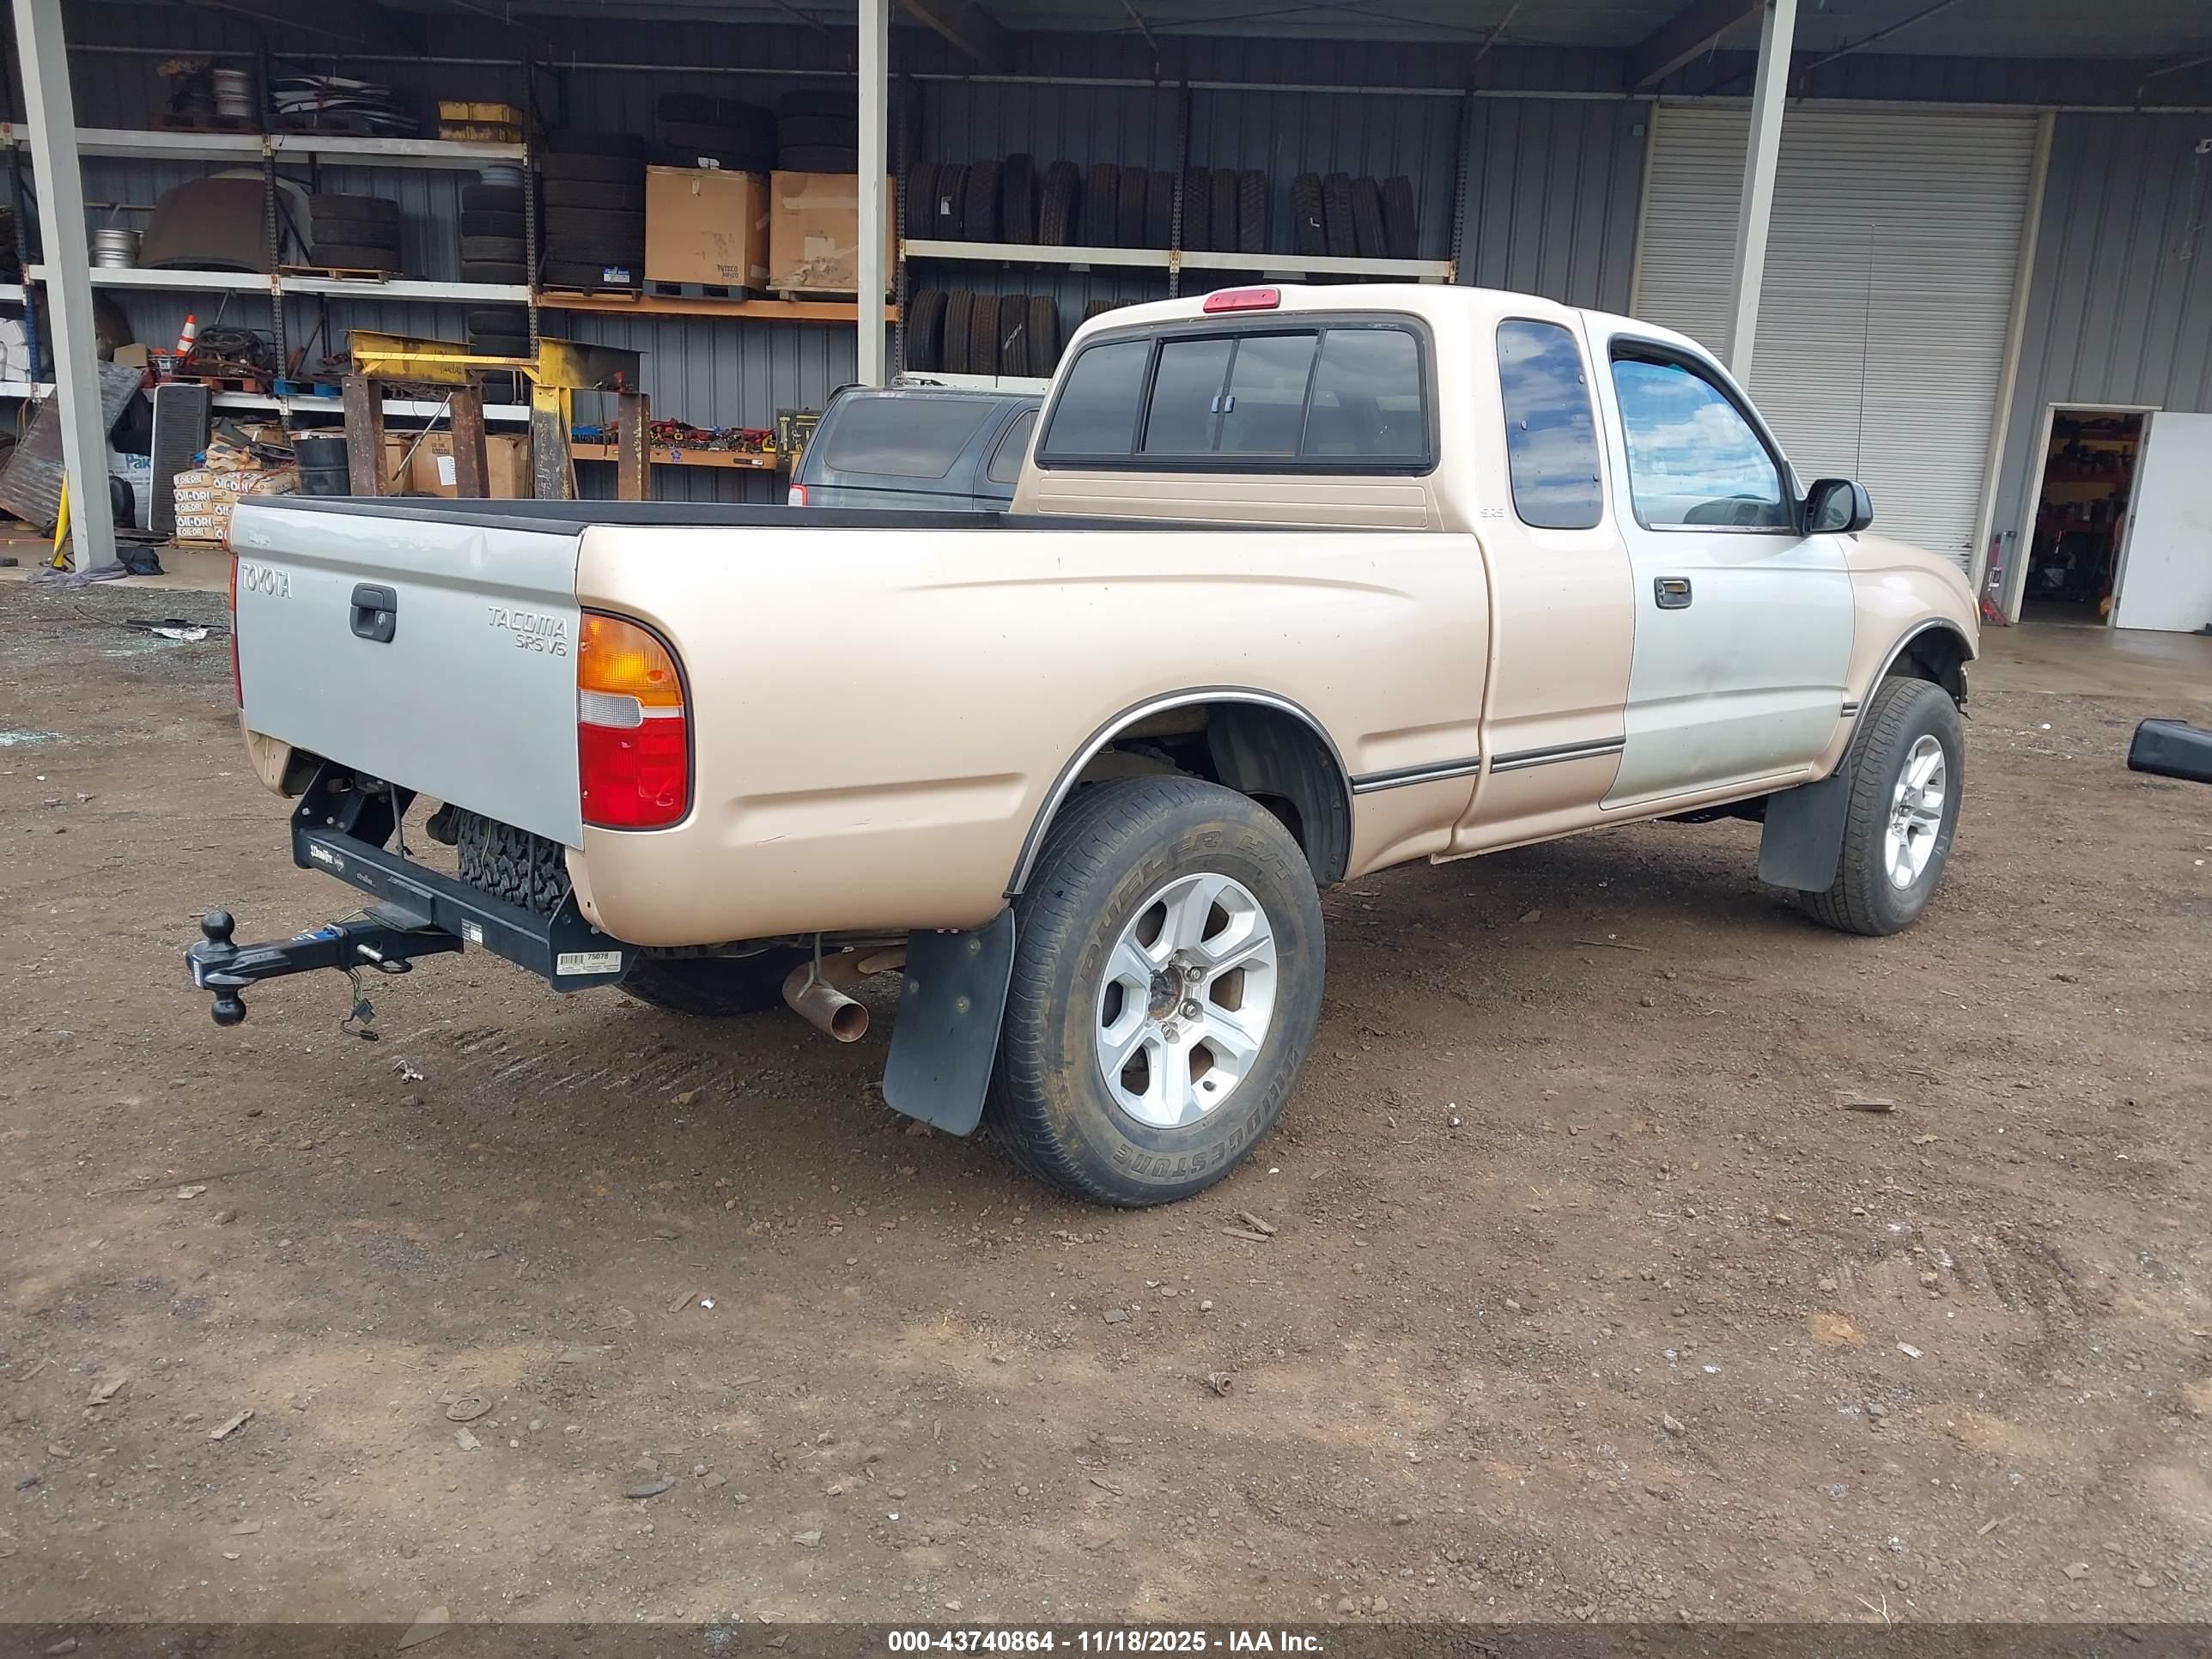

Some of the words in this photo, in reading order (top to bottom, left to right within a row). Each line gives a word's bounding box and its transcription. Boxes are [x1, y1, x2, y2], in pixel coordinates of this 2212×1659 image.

[176, 490, 212, 502] OIL-DRI
[177, 516, 213, 528] OIL-DRI
[241, 563, 293, 599] TOYOTA
[488, 605, 568, 640] TACOMA
[1112, 1045, 1299, 1178] BRIDGESTONE
